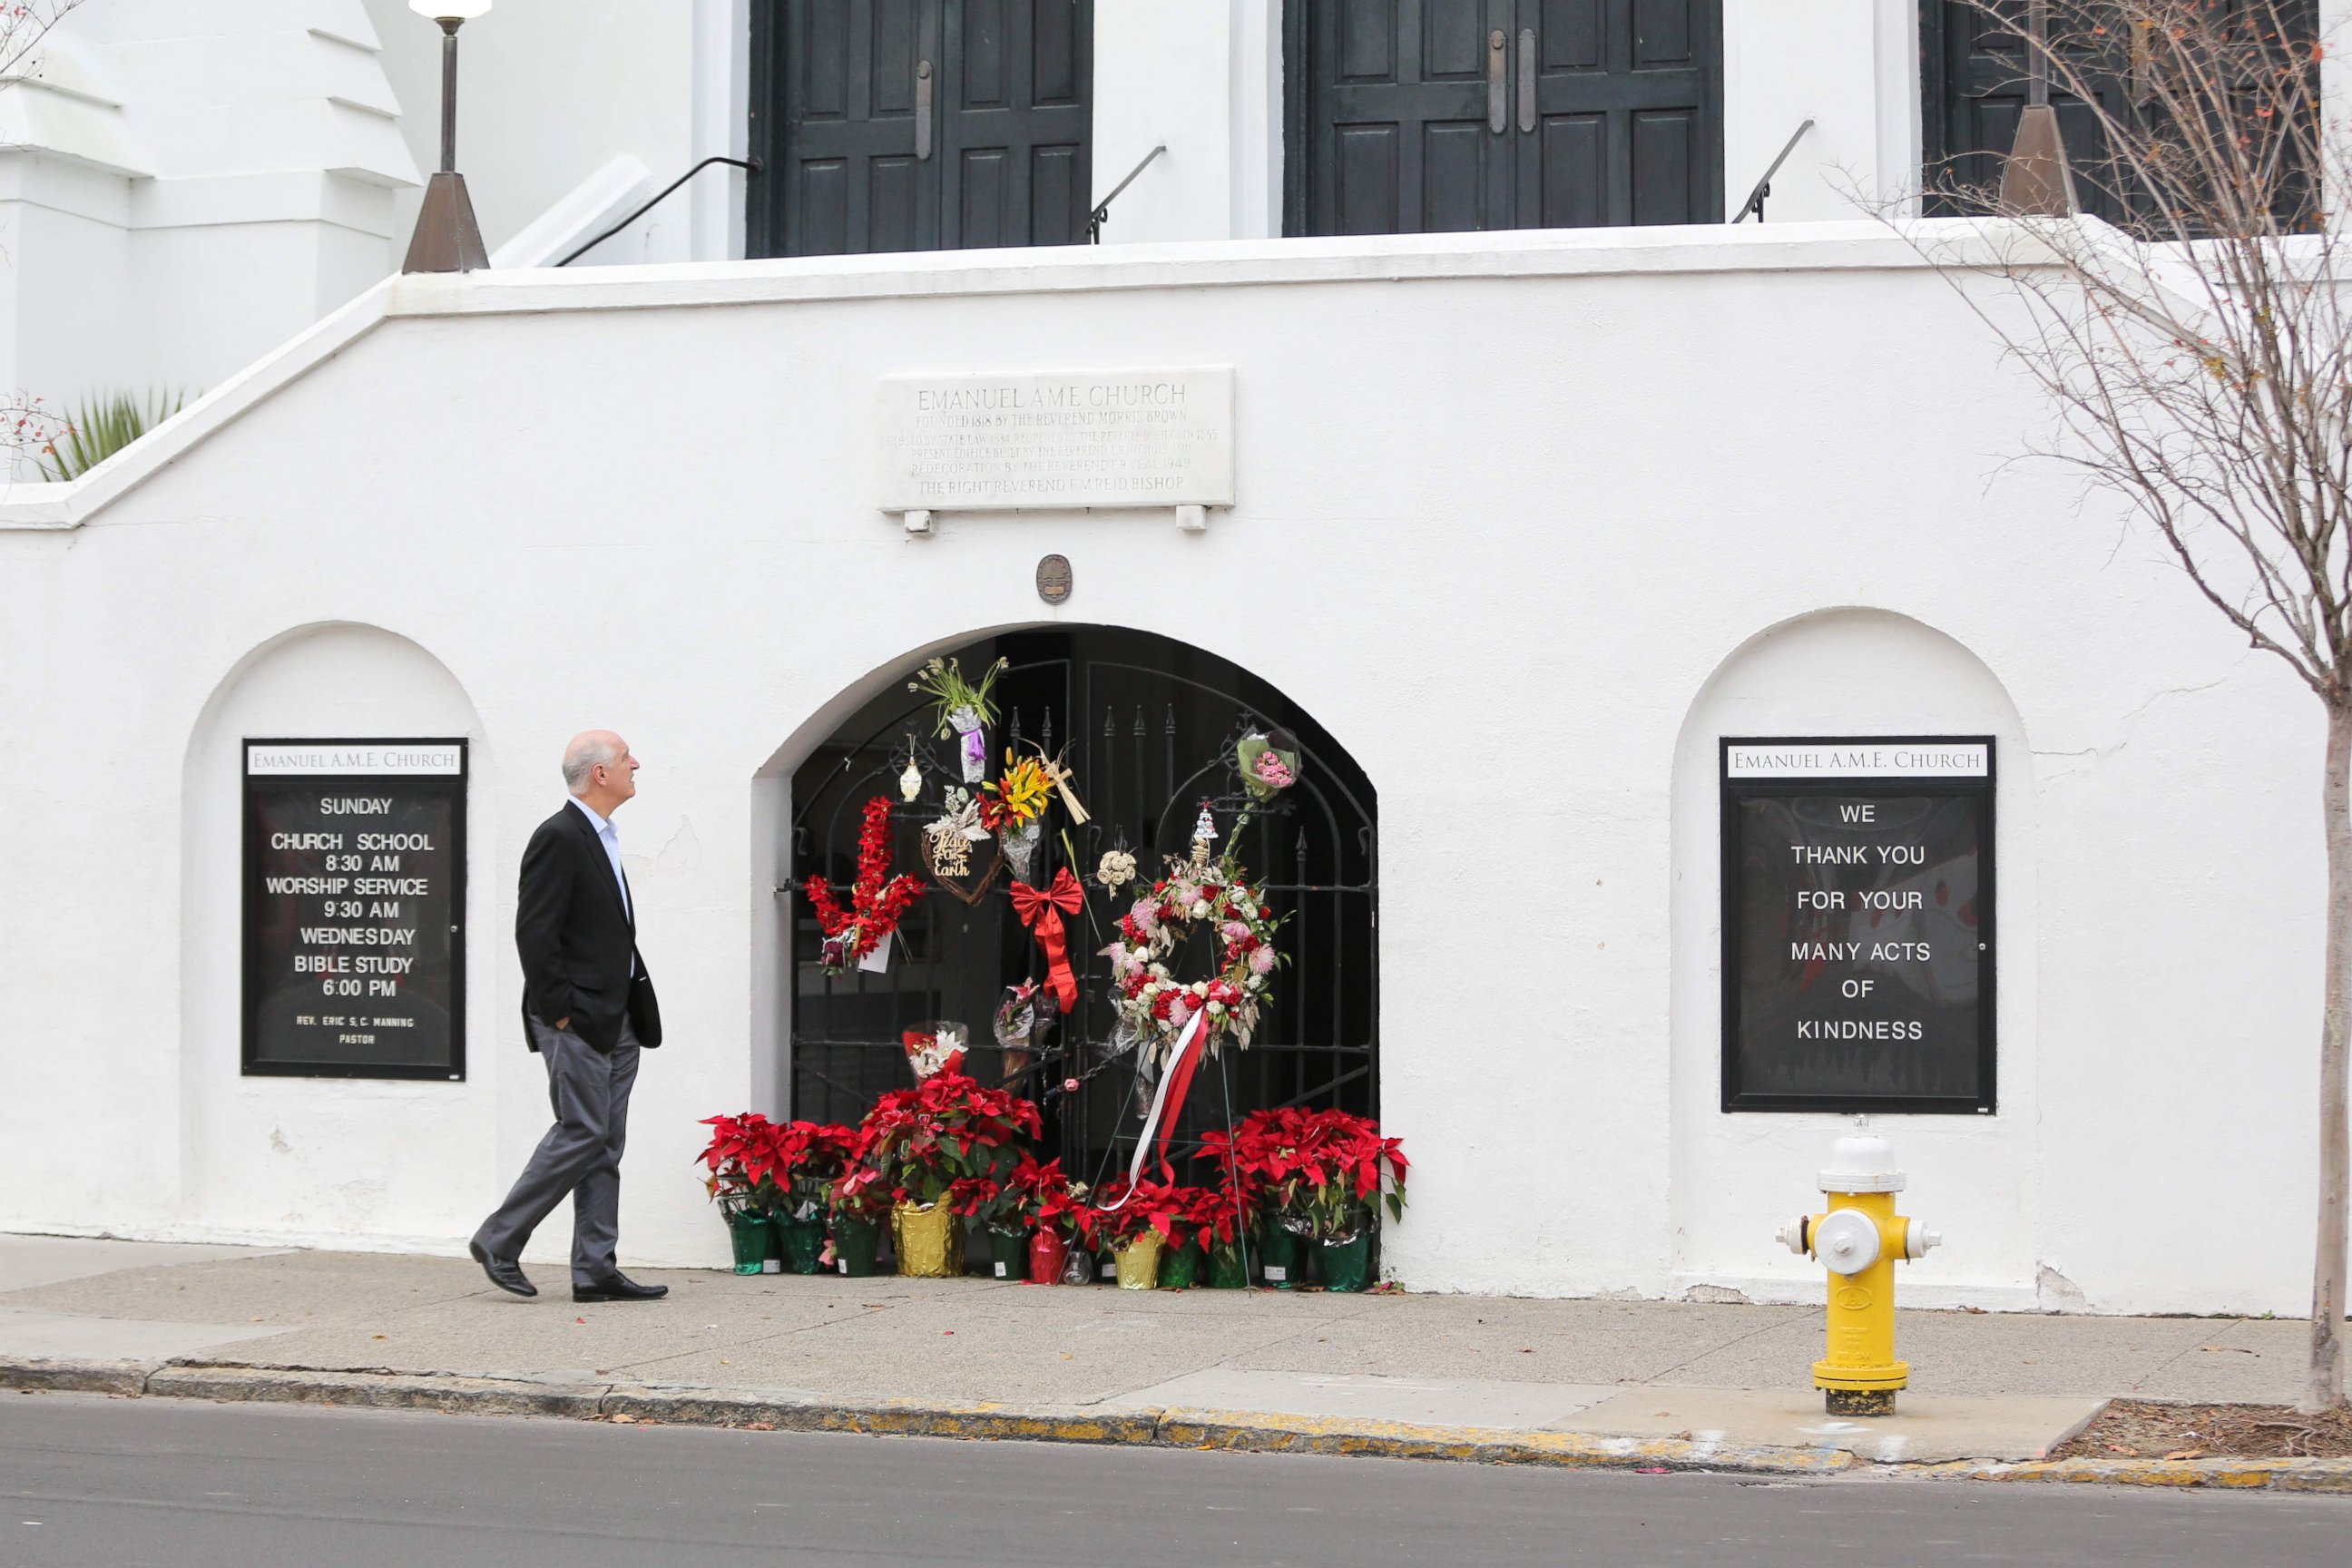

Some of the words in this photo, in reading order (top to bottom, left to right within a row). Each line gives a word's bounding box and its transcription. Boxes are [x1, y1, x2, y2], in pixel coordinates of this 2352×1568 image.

[918, 388, 1024, 410] EMANUEL
[1089, 383, 1186, 407] CHURCH
[972, 416, 992, 427] 1818
[995, 415, 1008, 426] BY
[1012, 414, 1033, 426] THE
[1036, 412, 1094, 426] REVEREND
[1099, 410, 1142, 425] MORRIS
[1146, 409, 1187, 423] BROWN
[938, 435, 965, 446] STATE
[968, 435, 986, 445] LAW
[1080, 431, 1097, 442] THE
[1005, 462, 1016, 472] BY
[919, 482, 944, 495] THE
[949, 481, 992, 494] RIGHT
[995, 479, 1065, 493] REVEREND
[1132, 476, 1184, 490] BISHOP
[254, 753, 325, 768] EMANUEL
[384, 752, 454, 767] CHURCH
[1736, 753, 1822, 768] EMANUEL
[1830, 752, 1886, 768] A.M.E.
[1895, 752, 1979, 768] CHURCH
[320, 799, 392, 814] SUNDAY
[1840, 805, 1875, 822] WE
[271, 833, 342, 849] CHURCH
[358, 833, 435, 850] SCHOOL
[326, 855, 362, 871] 8:30
[370, 856, 399, 871] AM
[1791, 846, 1867, 864] THANK
[1877, 846, 1924, 864] YOU
[935, 858, 970, 876] Earth
[266, 877, 348, 894] WORSHIP
[354, 878, 428, 895] SERVICE
[1798, 891, 1845, 909] FOR
[1859, 891, 1922, 909] YOUR
[325, 901, 363, 917] 9:30
[369, 902, 398, 917] AM
[300, 928, 416, 945] WEDNESDAY
[1792, 943, 1861, 960] MANY
[1870, 943, 1930, 961] ACTS
[295, 956, 350, 973] BIBLE
[356, 956, 413, 974] STUDY
[323, 979, 361, 995] 6:00
[369, 980, 396, 996] PM
[1842, 980, 1874, 998] OF
[297, 1015, 317, 1024] REV.
[323, 1016, 345, 1025] ERIC
[373, 1018, 414, 1027] MANNING
[339, 1034, 375, 1044] PASTOR
[1798, 1021, 1922, 1040] KINDNESS
